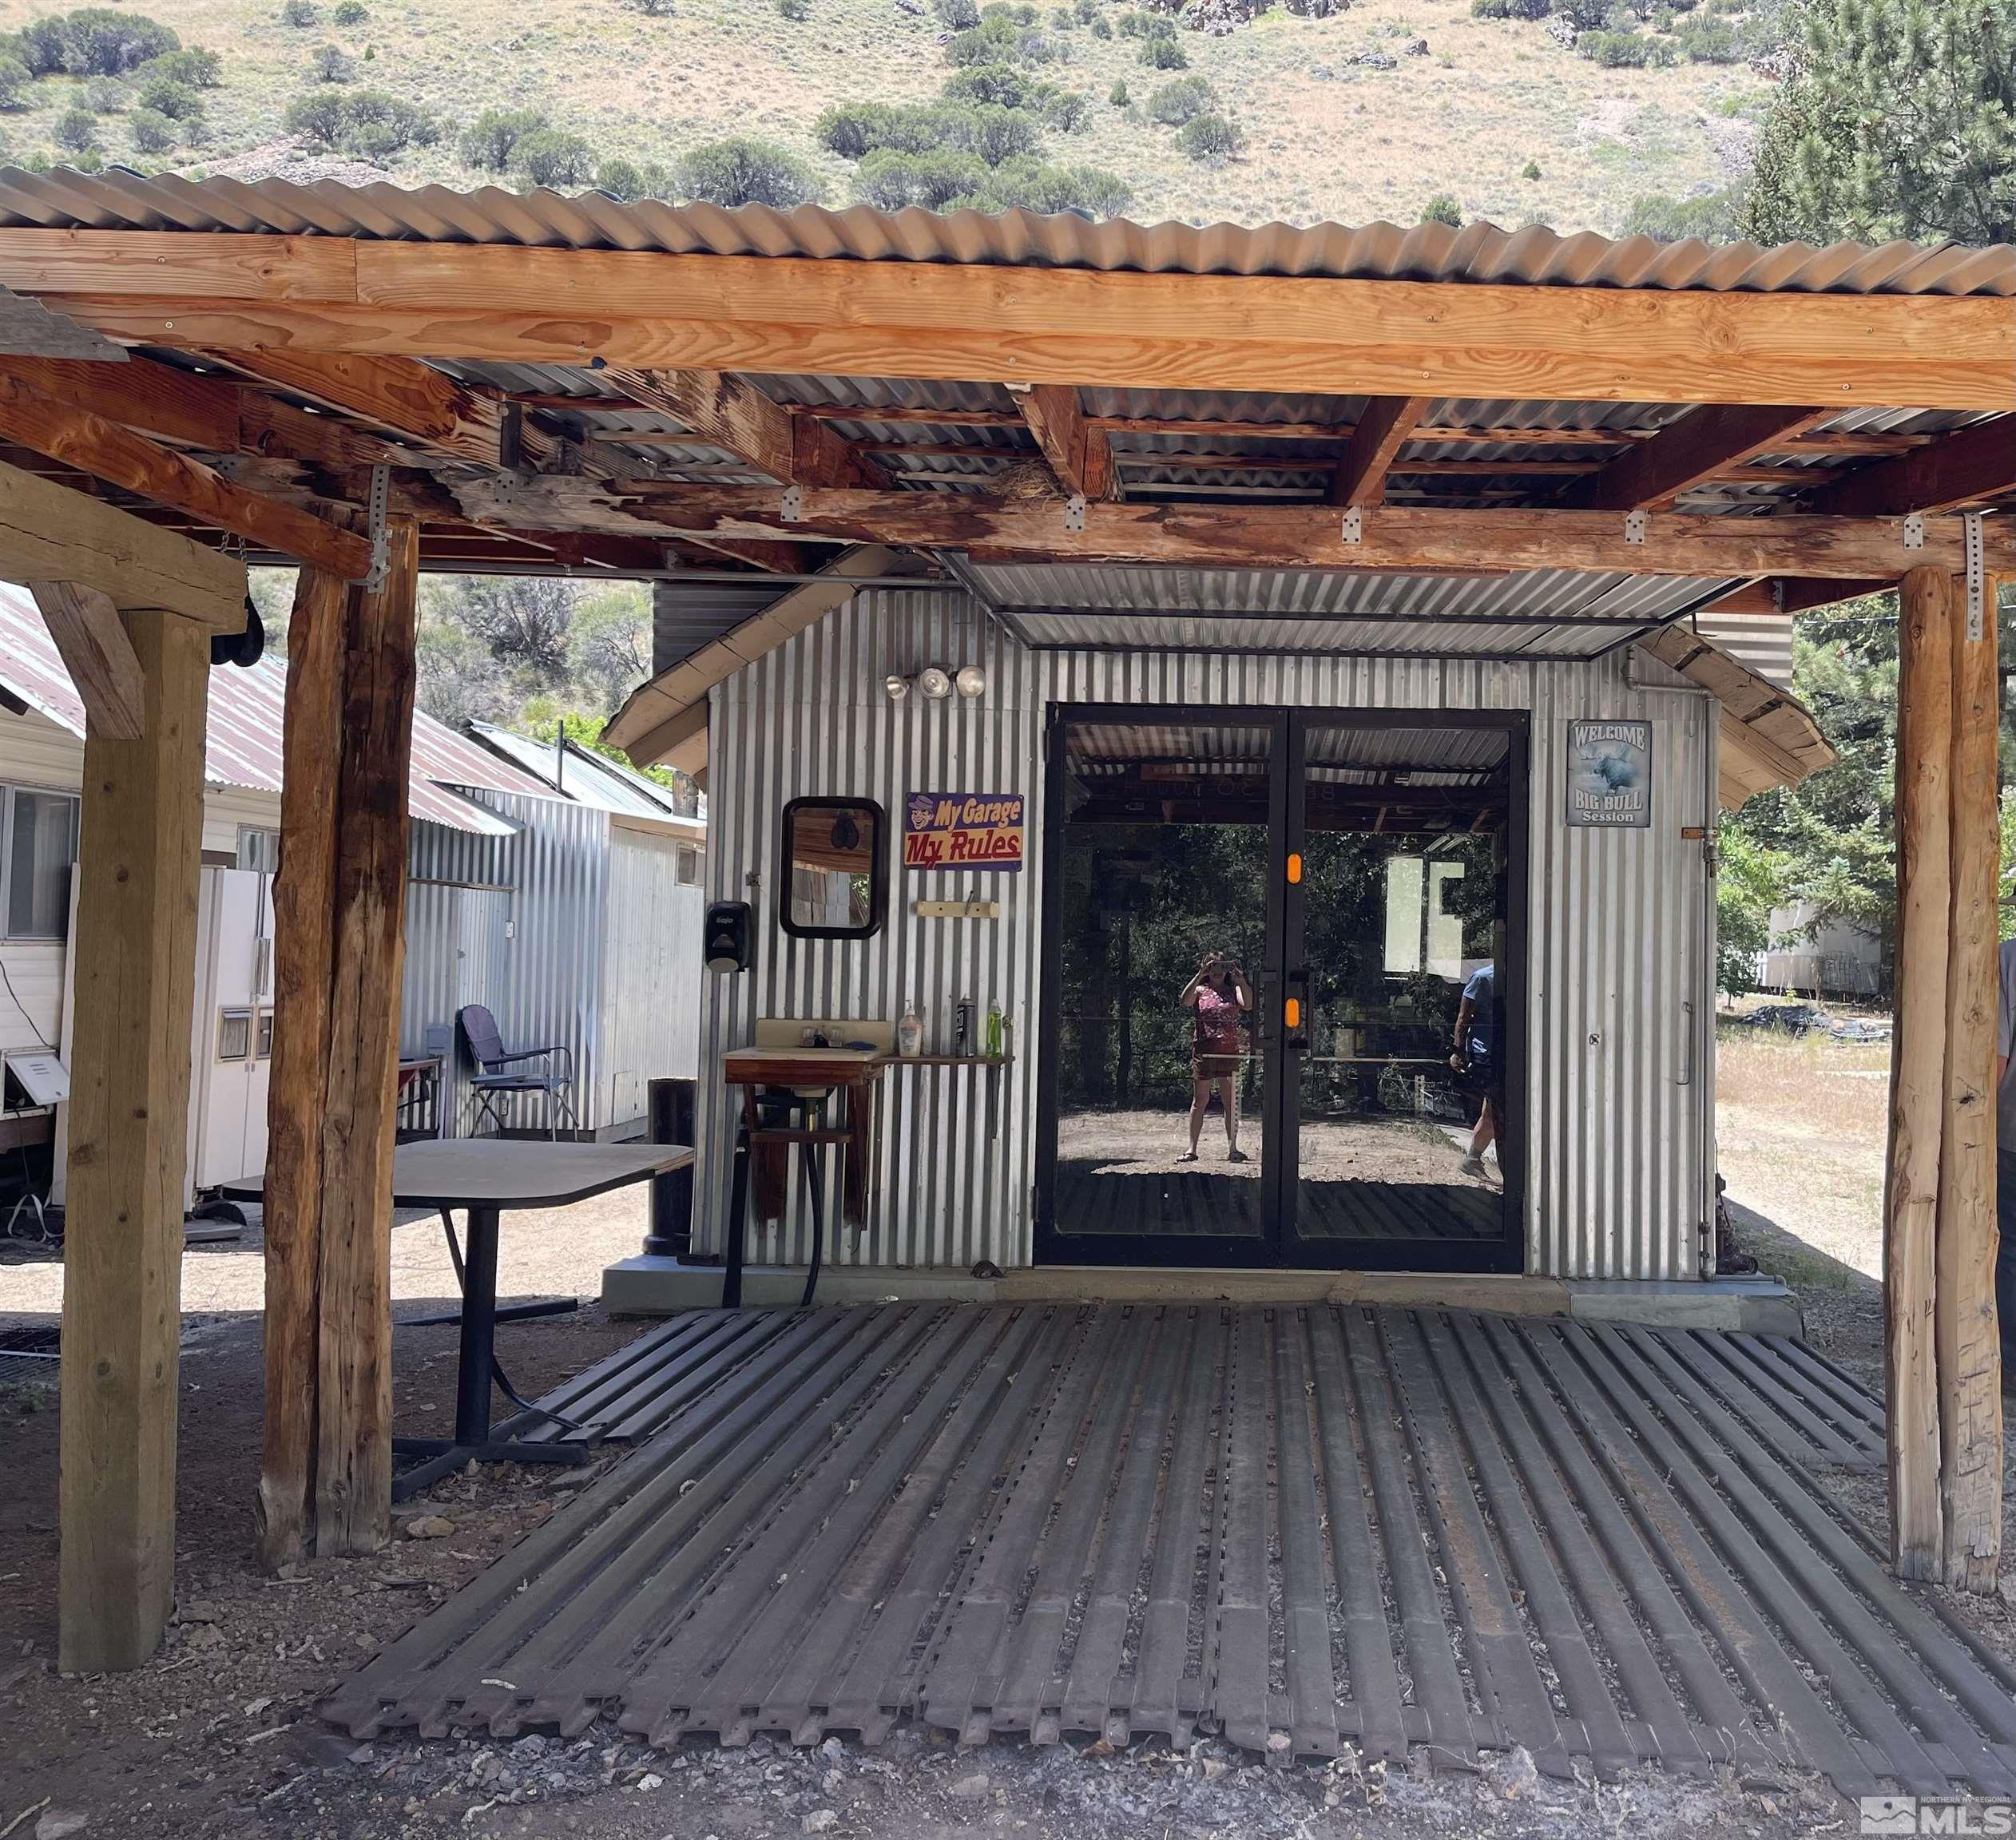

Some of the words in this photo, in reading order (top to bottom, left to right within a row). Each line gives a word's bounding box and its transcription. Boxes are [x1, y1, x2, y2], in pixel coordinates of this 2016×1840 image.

[1574, 725, 1645, 751] WELCOME
[1575, 788, 1600, 810] BIG
[1603, 791, 1642, 811] BULL
[934, 799, 961, 832] My
[962, 799, 1022, 829] Garage
[1582, 811, 1634, 823] Session
[906, 833, 943, 869] My
[950, 830, 1021, 860] Rules
